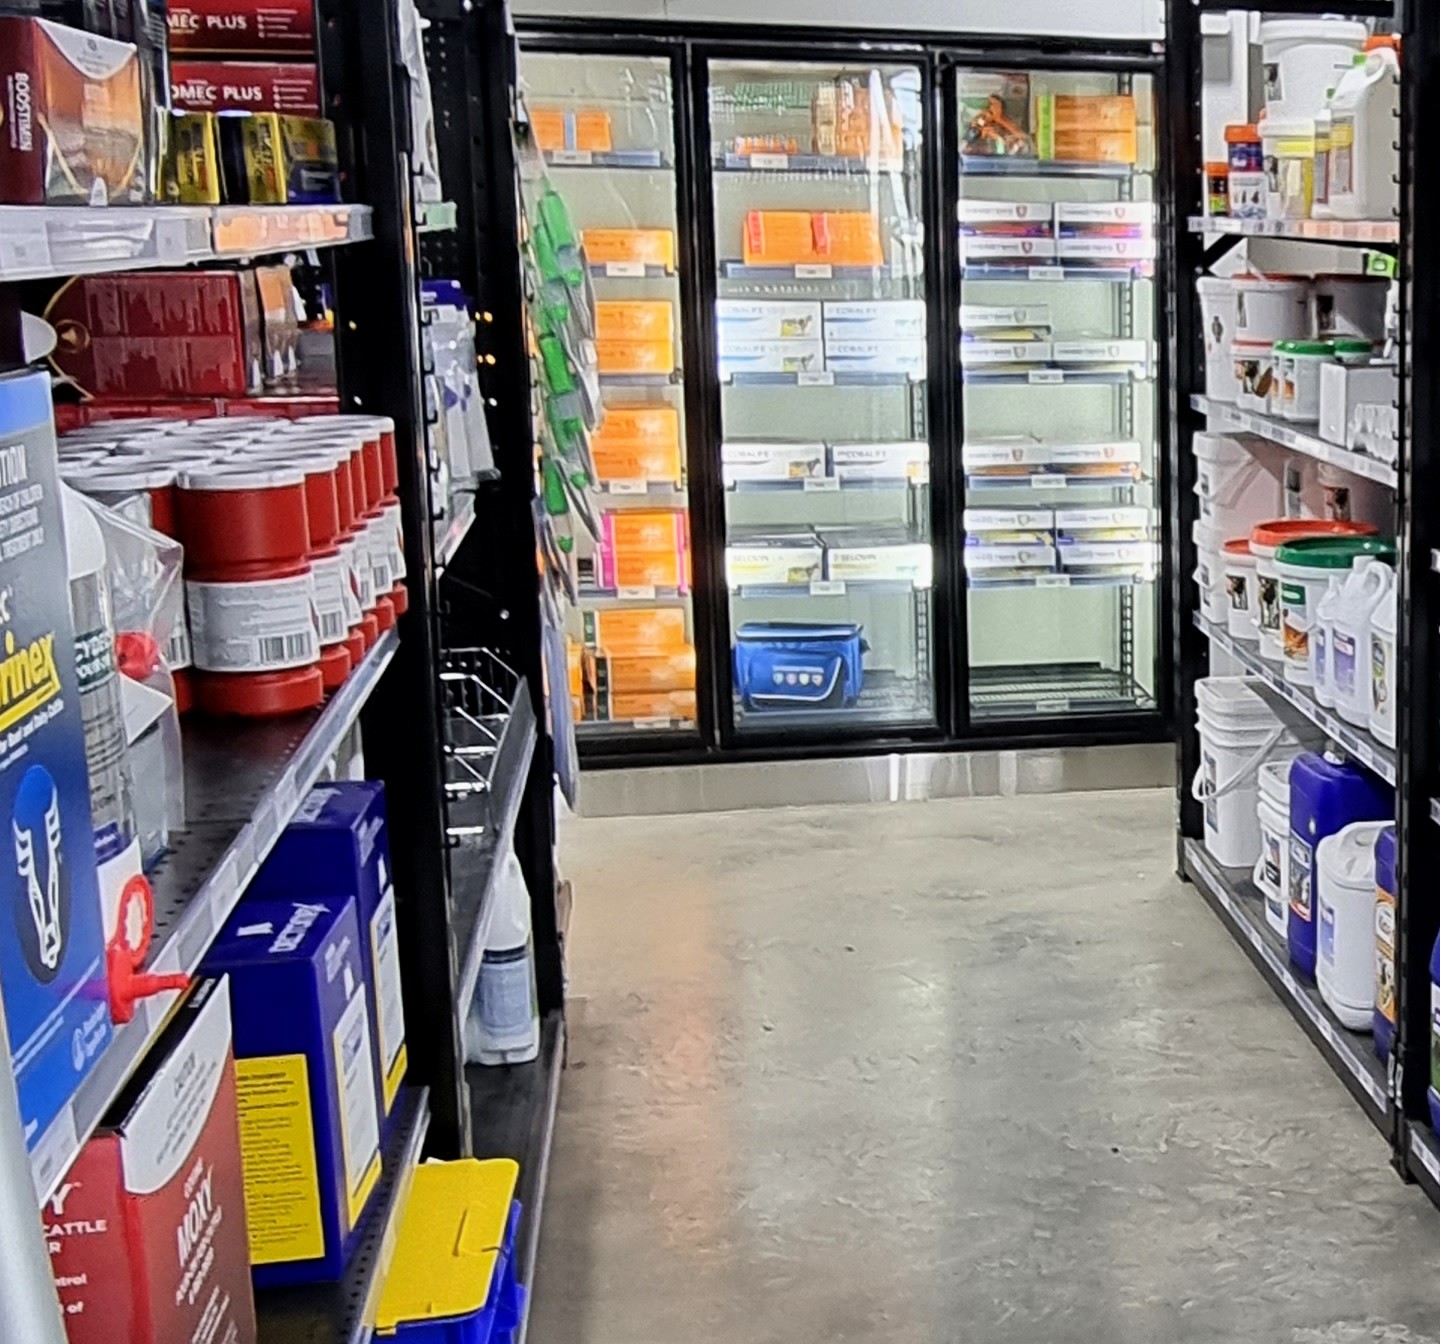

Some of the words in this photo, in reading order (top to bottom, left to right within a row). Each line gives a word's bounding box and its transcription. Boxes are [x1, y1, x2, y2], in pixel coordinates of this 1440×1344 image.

[206, 15, 247, 30] PLUS
[223, 85, 263, 101] PLUS
[176, 1164, 213, 1269] MOXY
